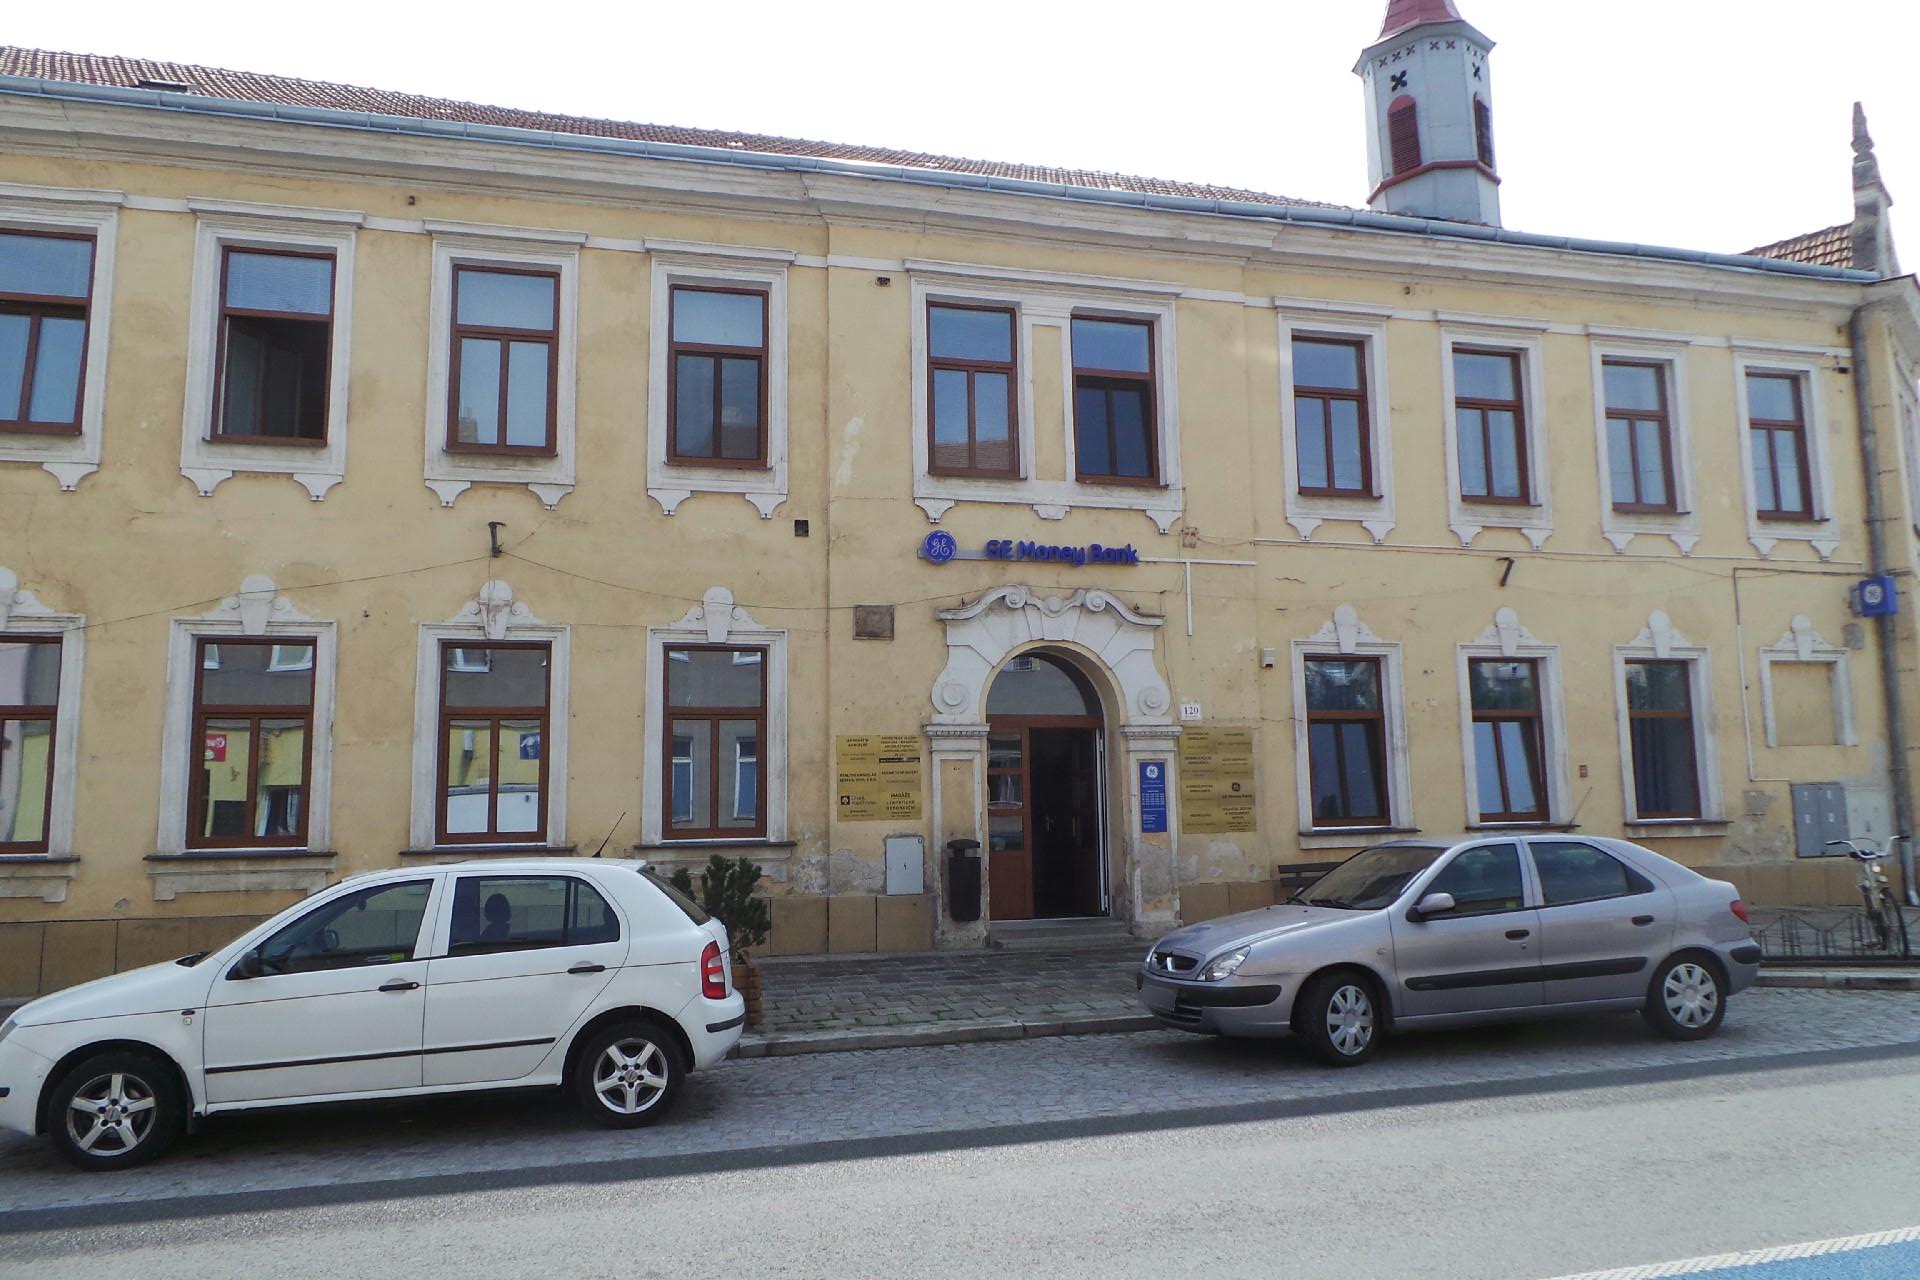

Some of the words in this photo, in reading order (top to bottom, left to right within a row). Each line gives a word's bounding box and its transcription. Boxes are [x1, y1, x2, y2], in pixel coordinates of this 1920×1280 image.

[986, 539, 1013, 559] GE
[1017, 540, 1086, 566] Money
[1088, 543, 1139, 565] Bank
